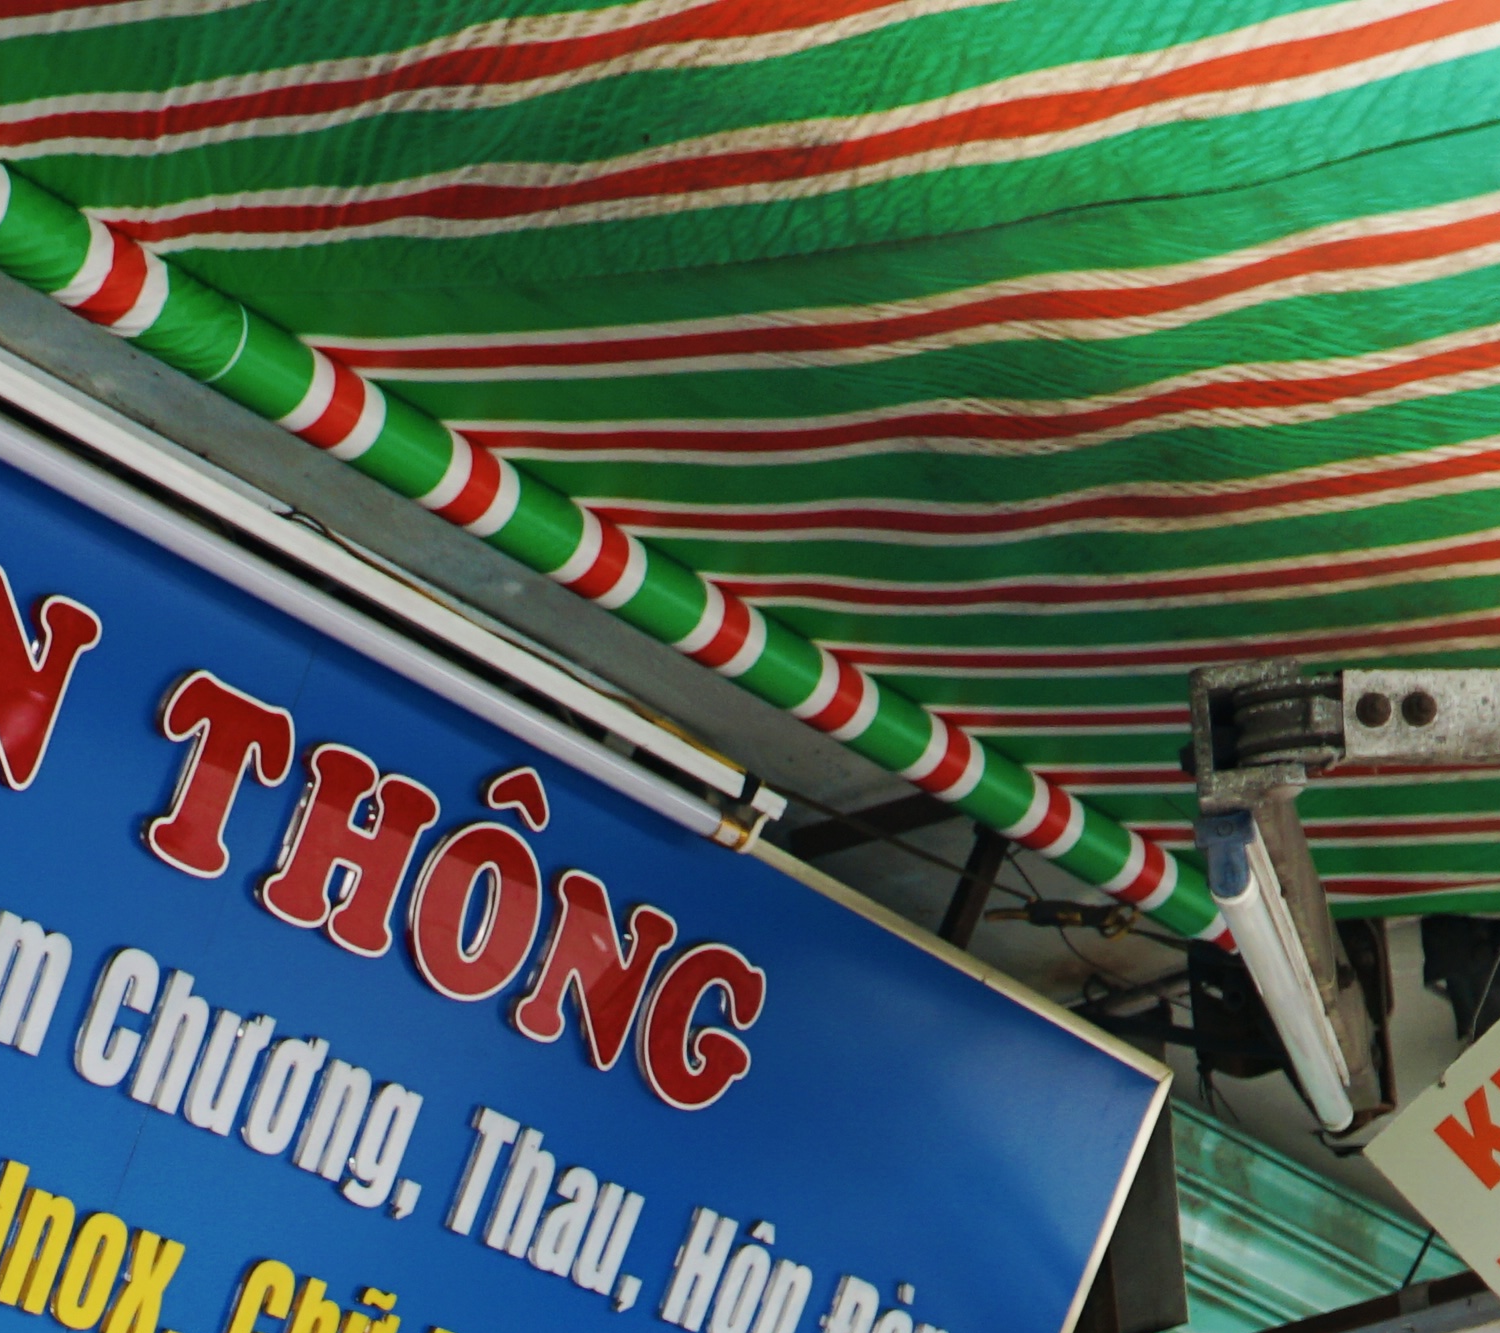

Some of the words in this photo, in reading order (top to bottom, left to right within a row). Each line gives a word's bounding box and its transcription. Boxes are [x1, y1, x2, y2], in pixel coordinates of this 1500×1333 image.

[144, 669, 769, 1112] THÔNG
[71, 944, 424, 1223] Chương,
[444, 1104, 647, 1316] Thau,
